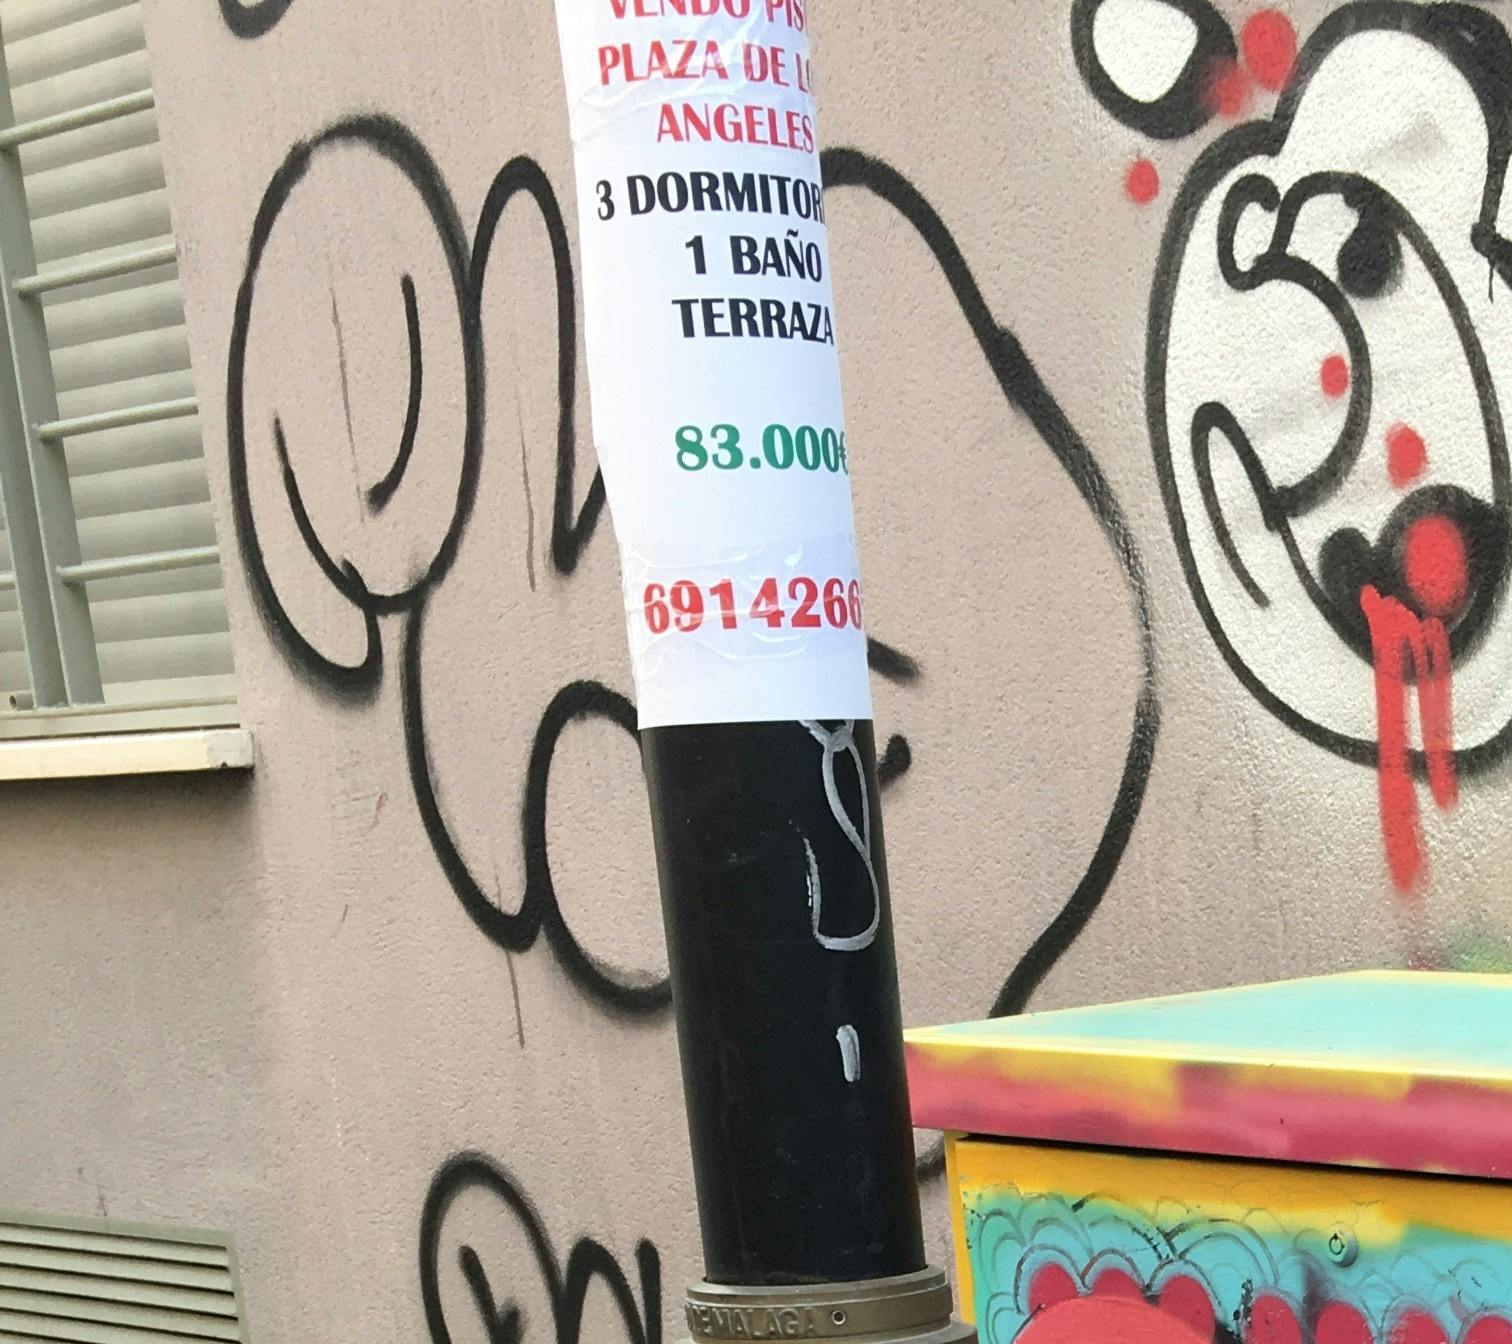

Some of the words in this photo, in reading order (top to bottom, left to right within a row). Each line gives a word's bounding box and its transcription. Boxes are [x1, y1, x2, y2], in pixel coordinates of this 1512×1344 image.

[765, 0, 806, 32] PIS
[597, 39, 729, 86] PLAZA
[742, 42, 790, 88] DE
[656, 103, 815, 154] ANGELES
[595, 179, 616, 221] 3
[626, 171, 825, 225] DORMITOR
[685, 235, 707, 275] 1
[730, 229, 823, 283] BAÑO
[671, 298, 834, 346] TERRAZA
